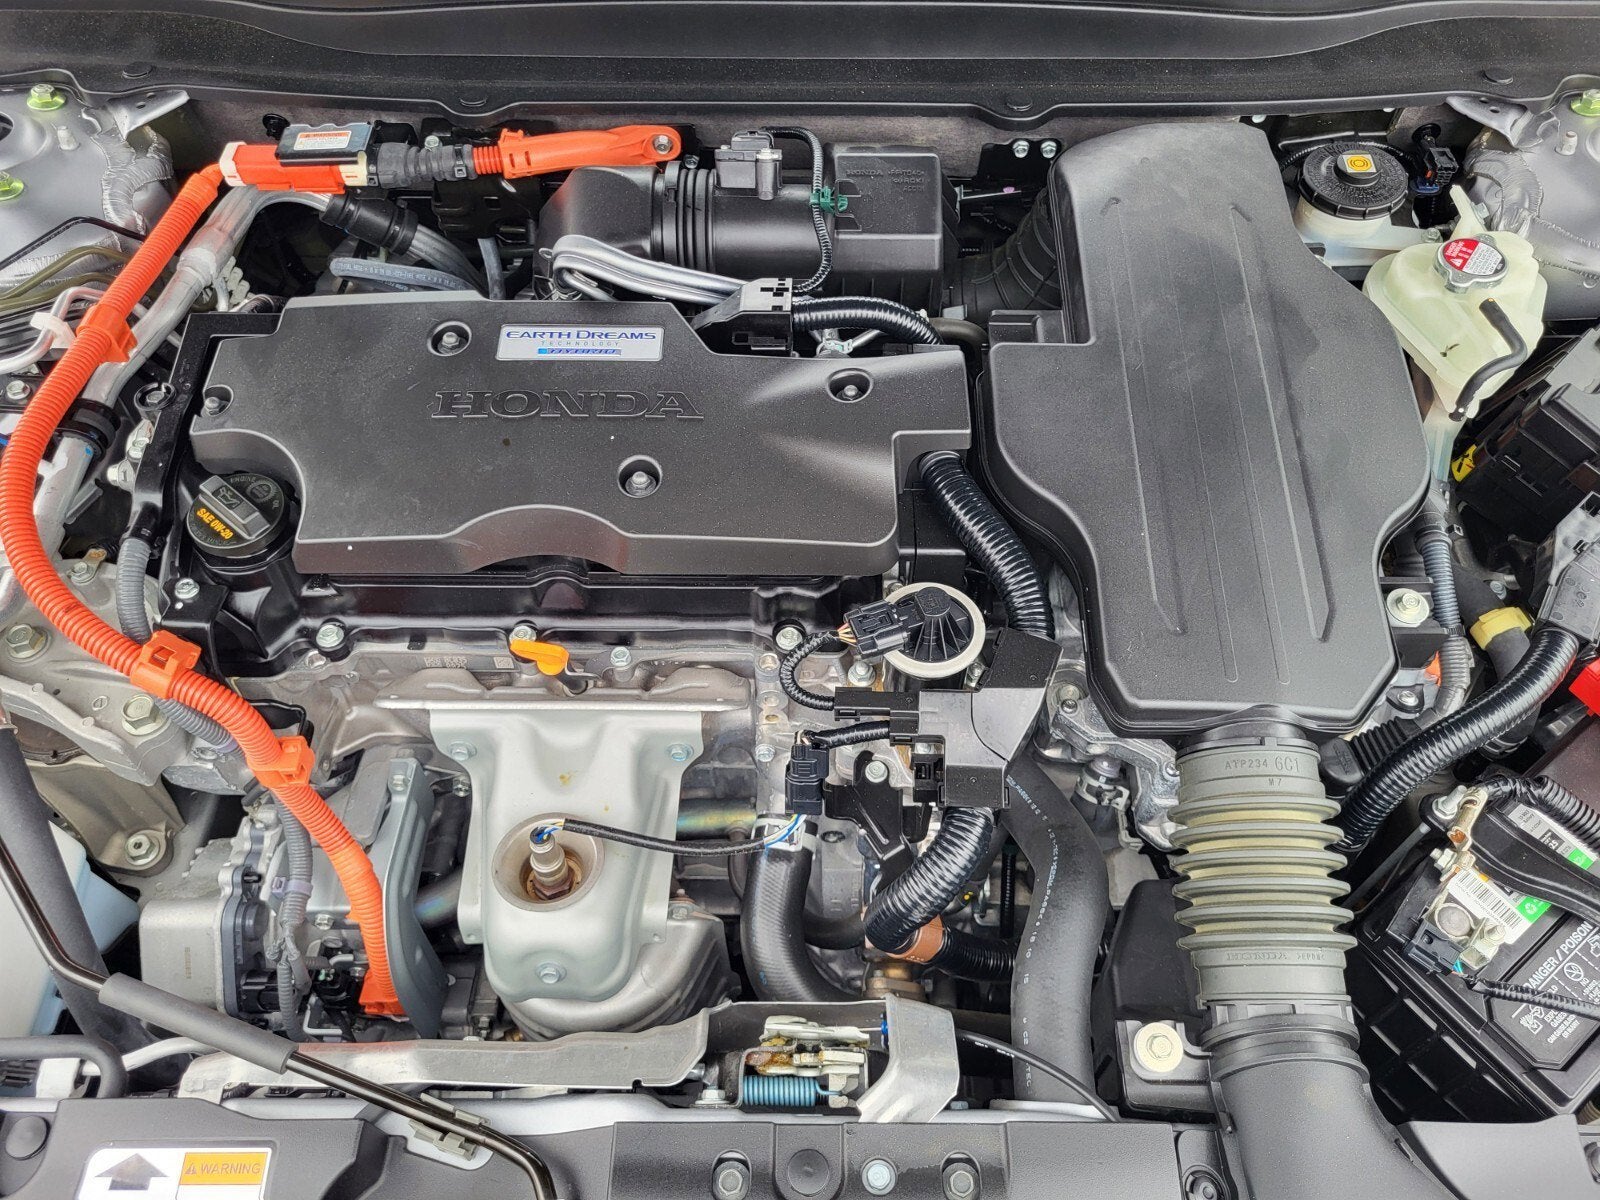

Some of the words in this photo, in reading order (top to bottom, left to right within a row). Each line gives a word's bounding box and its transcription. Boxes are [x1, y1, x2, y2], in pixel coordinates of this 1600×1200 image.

[506, 331, 571, 339] EARTH
[576, 330, 656, 340] DREAMS
[431, 390, 704, 418] HONDA
[196, 507, 215, 524] SAE
[210, 519, 234, 540] 0W-20
[1559, 921, 1593, 955] POISON
[1227, 951, 1289, 961] HONDA
[201, 1162, 262, 1175] WARNING
